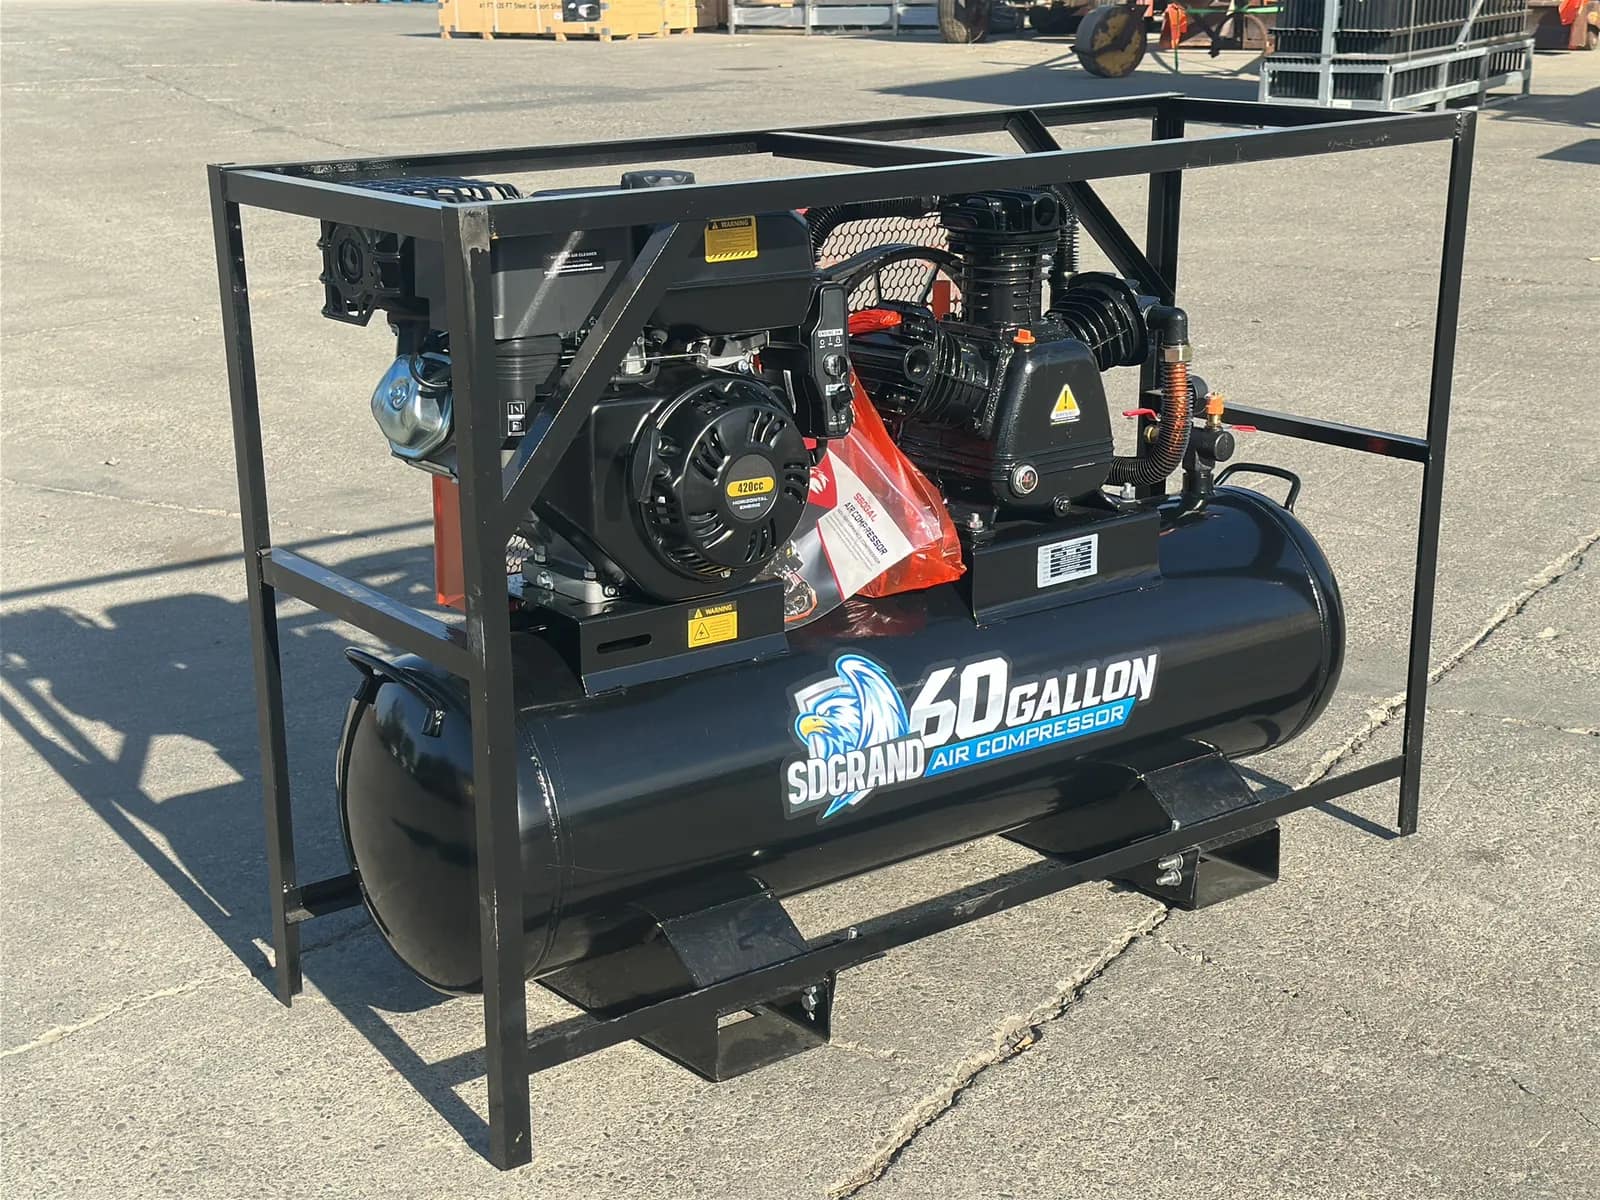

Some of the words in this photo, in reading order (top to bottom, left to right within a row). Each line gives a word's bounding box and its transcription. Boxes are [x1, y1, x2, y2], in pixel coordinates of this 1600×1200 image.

[528, 2, 550, 10] Caport
[720, 219, 750, 229] WARNING
[737, 481, 769, 493] 420cc
[844, 502, 855, 512] AIR
[850, 510, 888, 556] COMPRESSOR
[705, 603, 733, 616] WARNING
[909, 656, 1008, 749] 60
[1005, 654, 1157, 727] GALLON
[931, 746, 970, 771] AIR
[975, 705, 1125, 759] COMPRESSOR
[787, 738, 925, 806] SDGRAND
